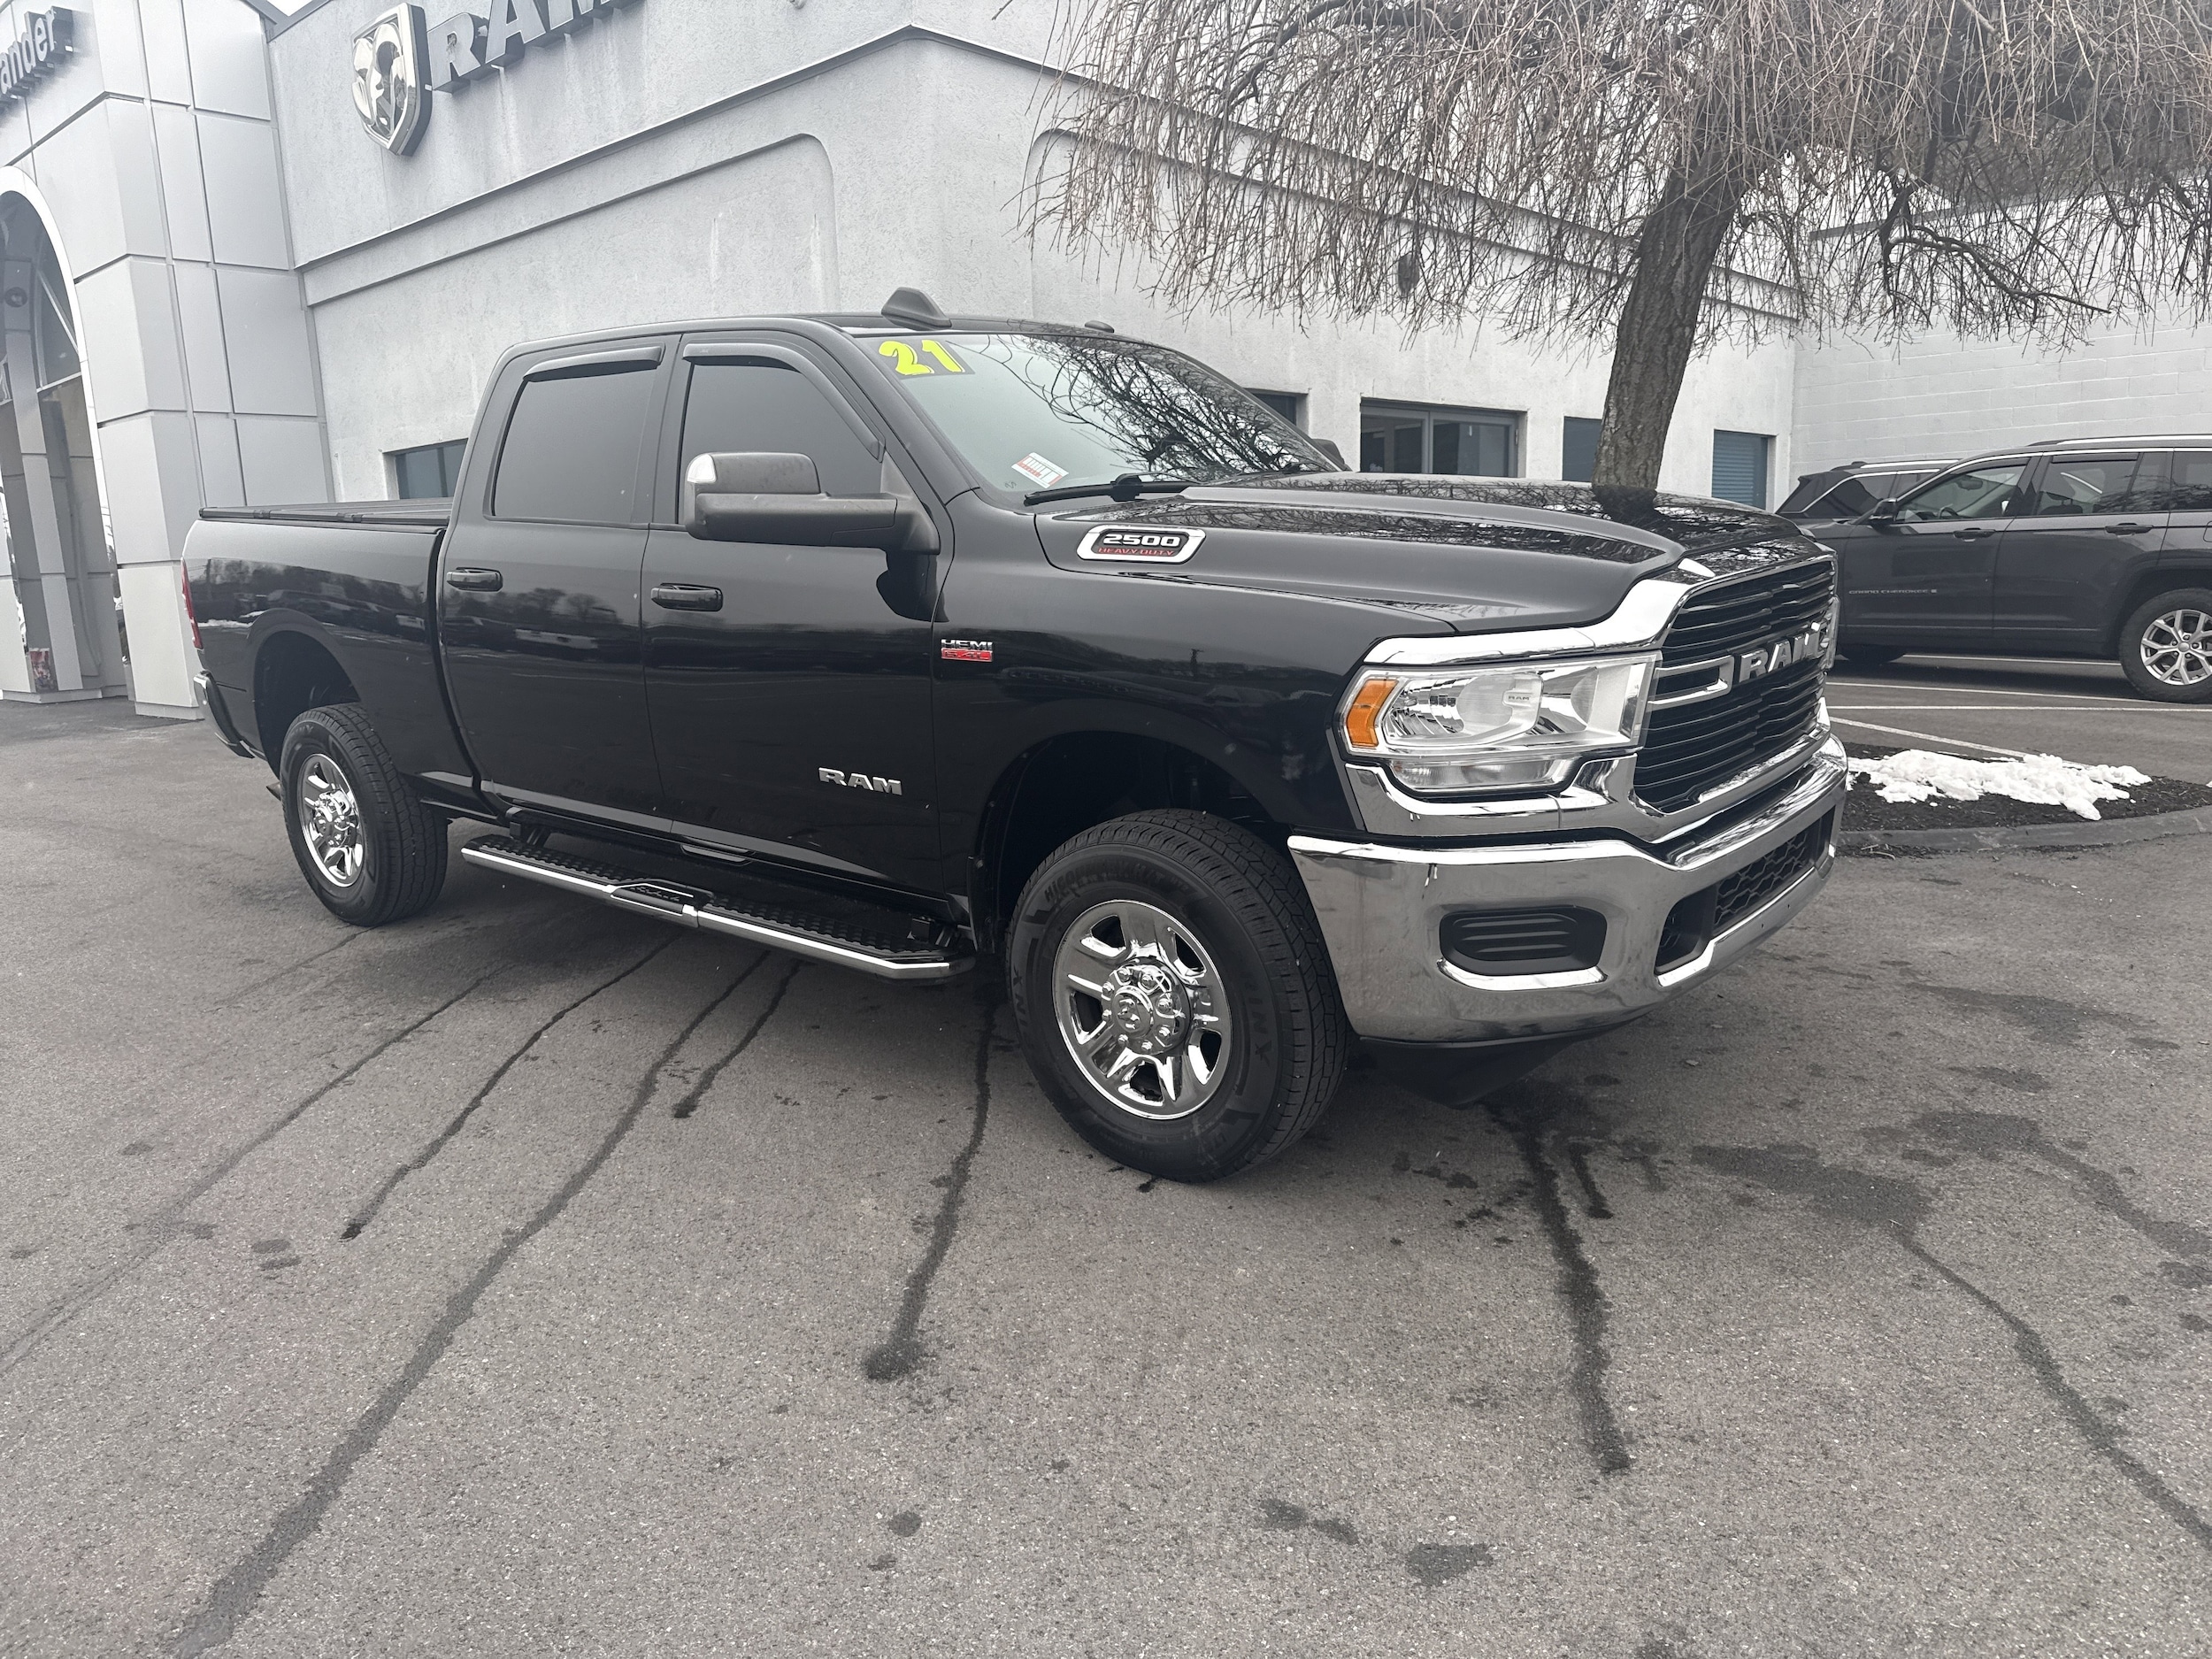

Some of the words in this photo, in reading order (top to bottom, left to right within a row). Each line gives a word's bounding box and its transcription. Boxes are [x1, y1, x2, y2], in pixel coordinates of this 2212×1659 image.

[427, 0, 611, 90] RA
[879, 340, 966, 376] 21
[1103, 534, 1180, 547] 2500
[941, 639, 993, 650] HEMI
[1739, 631, 1821, 683] RAM
[818, 767, 902, 795] RAM
